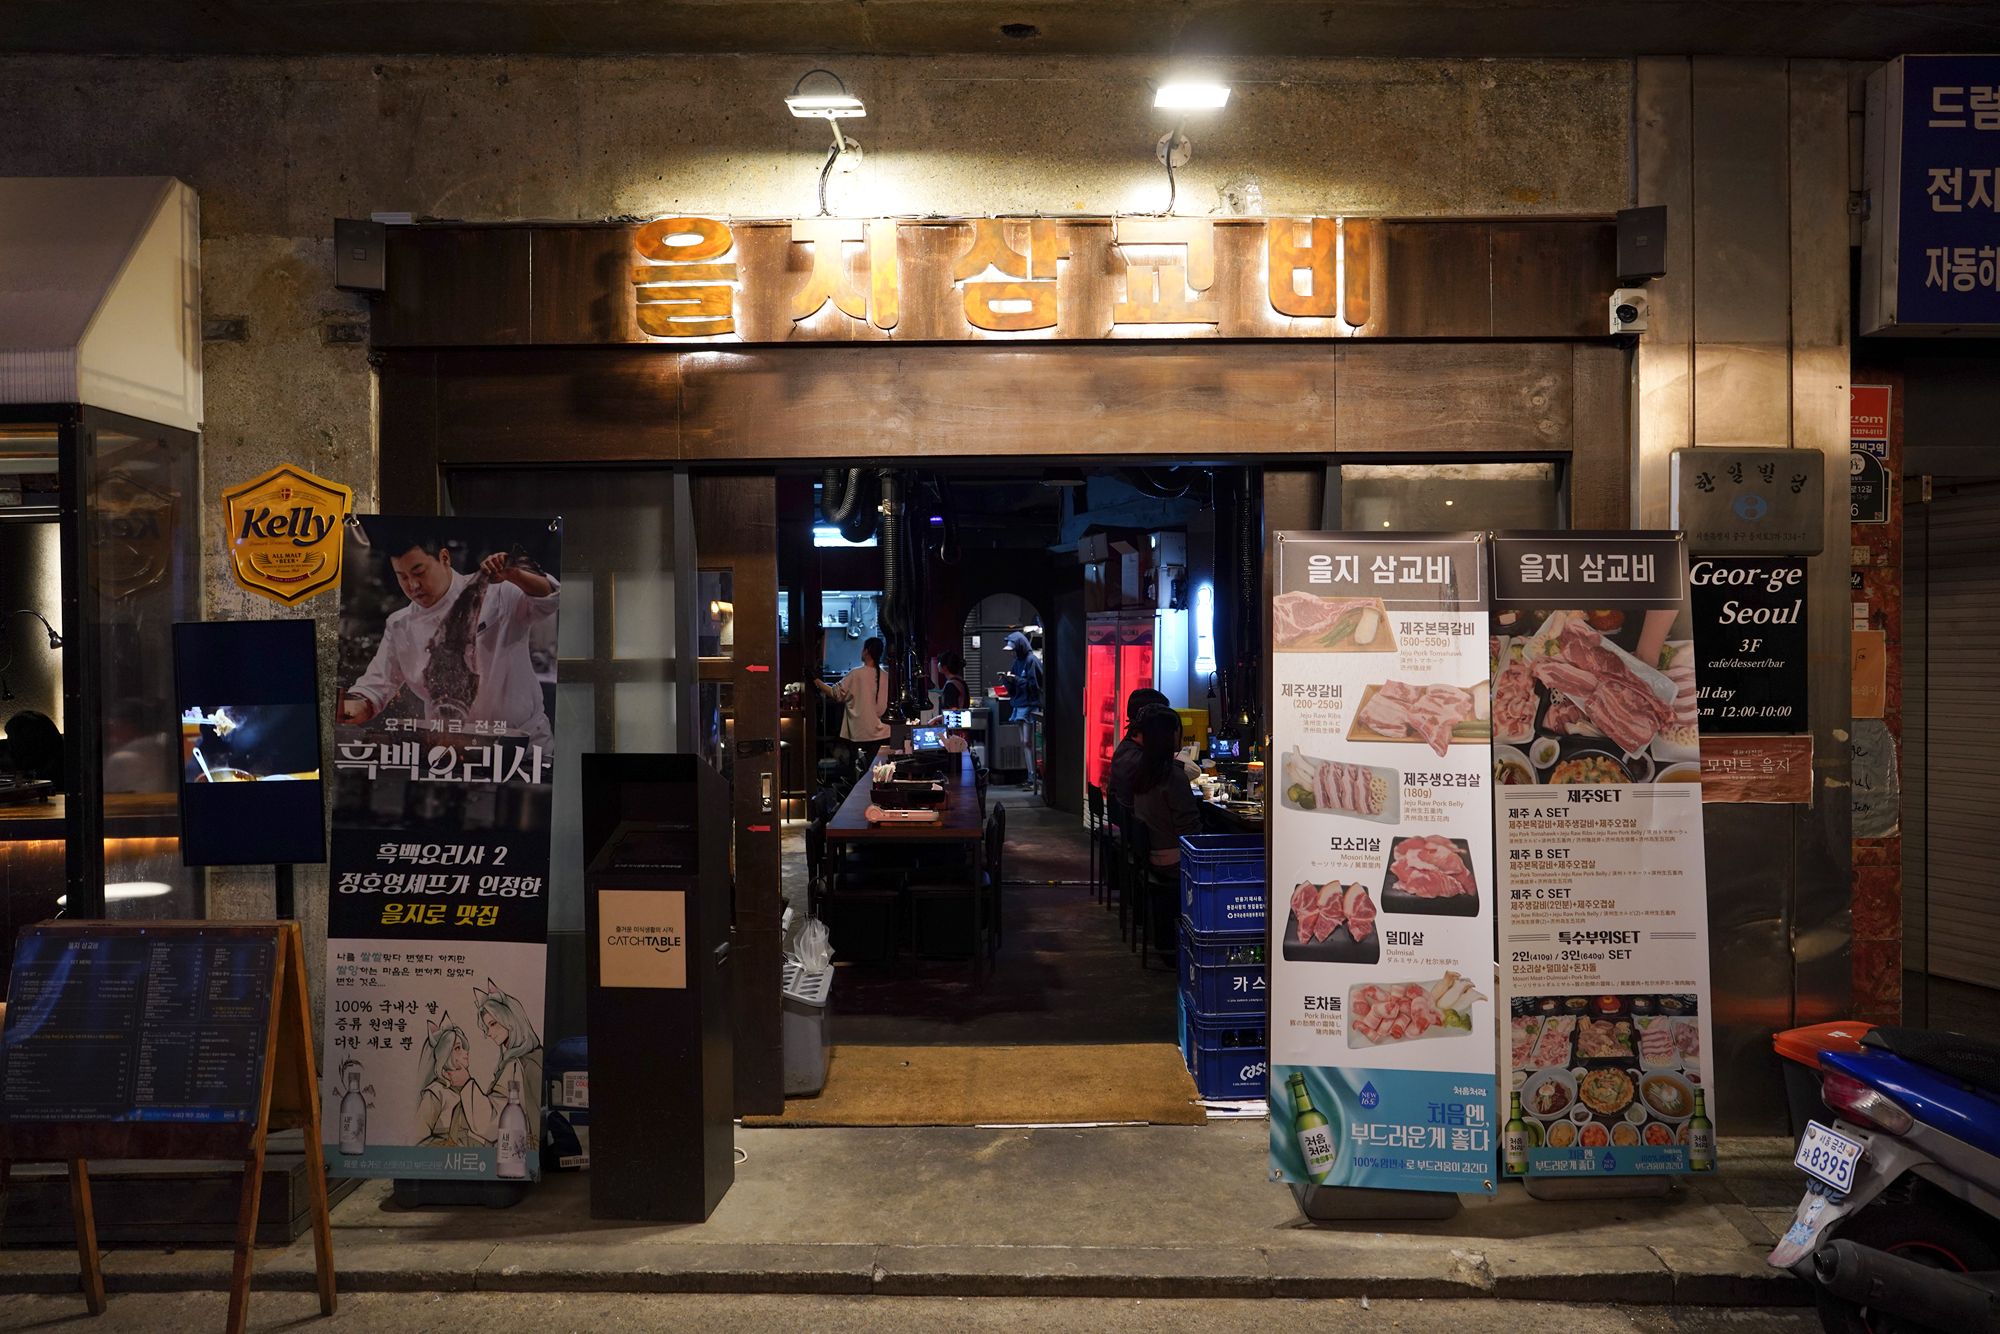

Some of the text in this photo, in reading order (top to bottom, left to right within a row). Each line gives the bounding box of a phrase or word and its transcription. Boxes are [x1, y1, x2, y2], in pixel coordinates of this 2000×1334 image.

[632, 217, 1371, 338] 을지삼교비
[241, 507, 336, 547] Kelly
[1307, 554, 1451, 585] 을지 삼교비
[1519, 553, 1655, 583] 을지 삼교비
[1689, 561, 1803, 593] Geor-ge
[1719, 600, 1802, 625] Seoul
[1400, 622, 1475, 636] 제주본목갈비
[1739, 638, 1762, 653] 3F
[1708, 658, 1785, 669] cafe/dessert/bar
[1281, 684, 1342, 698] 제주생갈비
[1712, 687, 1736, 702] day
[1720, 706, 1792, 718] 12:00-10:00
[385, 717, 508, 735] 요리 계급 전쟁
[334, 739, 552, 785] 흑백요리사
[1705, 757, 1790, 774] 모먼트 을지
[1404, 772, 1481, 788] 제주생오겹살
[1404, 788, 1432, 799] (180g)
[1567, 789, 1622, 803] 제주SET
[1508, 807, 1570, 819] 제주 A SET
[1331, 837, 1381, 852] 모소리살
[376, 842, 508, 866] 흑백요리사 2
[1509, 849, 1570, 860] 제주 B SET
[478, 874, 542, 898] 인정한
[1511, 888, 1571, 900] 제주 C SET
[381, 903, 500, 927] 을지로 맛집
[607, 936, 681, 947] CATCHTABLE
[1386, 931, 1424, 946] 덜미살
[1558, 930, 1641, 945] 특수부위SET
[1608, 949, 1632, 960] SET
[335, 1000, 439, 1015] 100% 국내산 쌀
[1304, 996, 1341, 1011] 돈차돌
[335, 1017, 408, 1033] 증류 원액을
[334, 1036, 361, 1050] 더한
[367, 1036, 393, 1050] 새로
[1305, 1133, 1326, 1147] 처음
[1351, 1123, 1490, 1152] 부드러운게 좋다
[1309, 1145, 1331, 1157] 처럼
[444, 1153, 479, 1172] 새로
[1811, 1147, 1849, 1182] 8395
